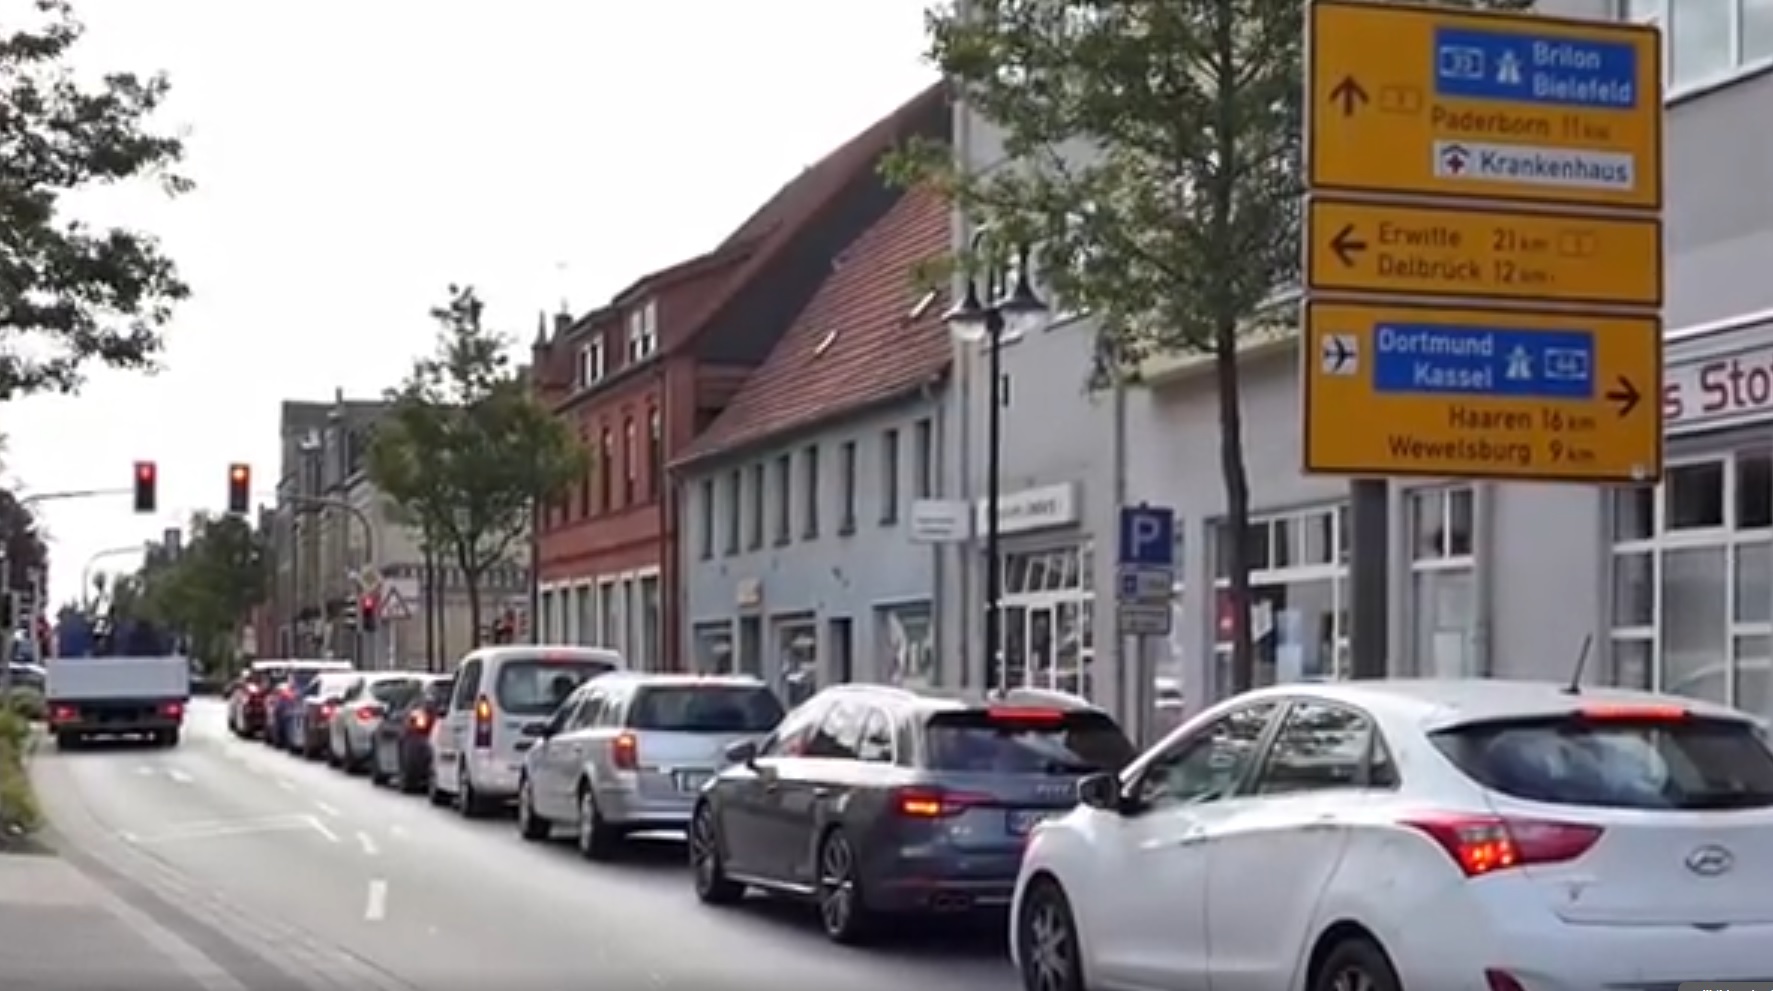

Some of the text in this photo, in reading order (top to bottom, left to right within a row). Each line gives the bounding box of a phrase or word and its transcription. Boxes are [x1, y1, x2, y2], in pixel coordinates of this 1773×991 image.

[1532, 42, 1601, 70] Brilon
[1532, 73, 1632, 106] Bielefeld
[1431, 105, 1549, 137] Paderborn
[1562, 114, 1579, 139] 11
[1479, 151, 1630, 184] Krankenhaus
[1377, 221, 1463, 249] Erwitte
[1492, 227, 1516, 251] 21
[1493, 259, 1516, 284] 12
[1377, 328, 1495, 358] Dortmund
[1413, 361, 1494, 389] Kassel
[1448, 404, 1597, 432] Haaren 16 km
[1388, 433, 1597, 464] Wewelsburg 9 km
[1130, 515, 1161, 558] P
